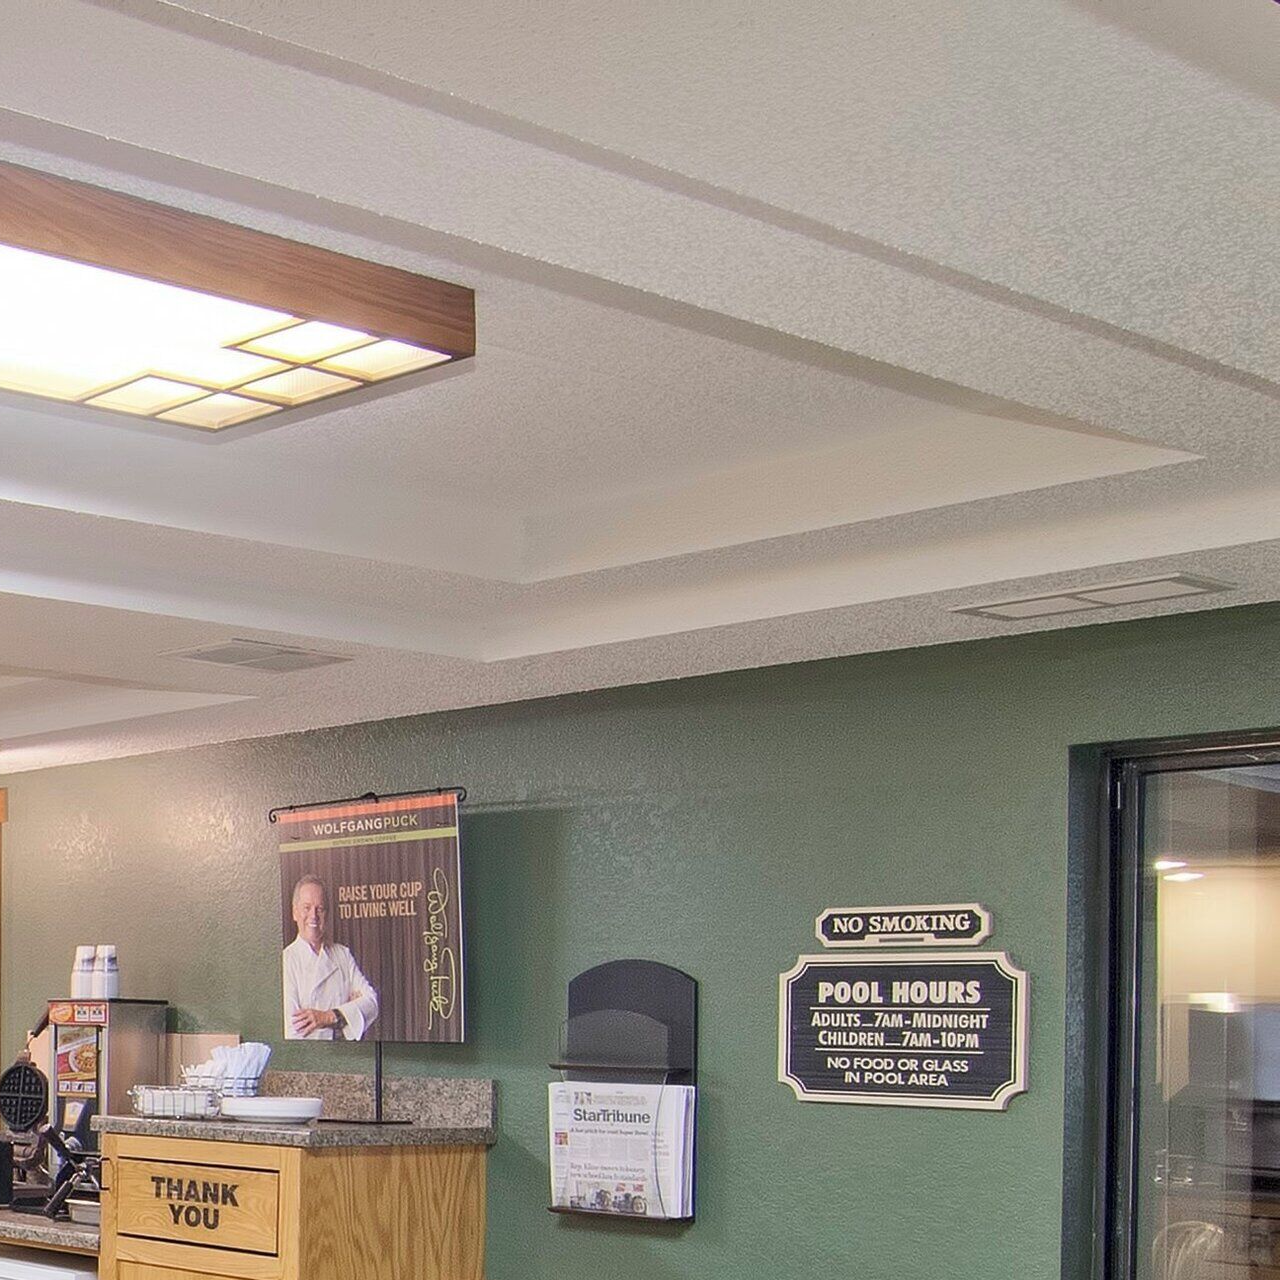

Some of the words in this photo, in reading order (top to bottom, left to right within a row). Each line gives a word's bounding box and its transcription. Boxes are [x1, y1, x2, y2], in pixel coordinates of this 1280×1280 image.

[339, 884, 366, 902] RAISE
[368, 882, 396, 900] YOUR
[399, 881, 422, 898] CUP
[338, 902, 352, 920] TO
[353, 901, 387, 919] LIVING
[389, 899, 418, 917] WELL
[833, 917, 863, 933] NO
[868, 913, 971, 933] SMOKING
[818, 981, 883, 1004] POOL
[892, 980, 982, 1004] HOURS
[827, 1056, 851, 1070] NO
[853, 1056, 894, 1071] FOOD
[899, 1057, 920, 1071] OR
[923, 1058, 969, 1073] GLASS
[844, 1071, 861, 1084] IN
[864, 1071, 906, 1086] POOL
[907, 1072, 949, 1087] AREA
[573, 1108, 651, 1124] StarTribune
[151, 1176, 240, 1207] THANK
[168, 1203, 221, 1230] YOU
